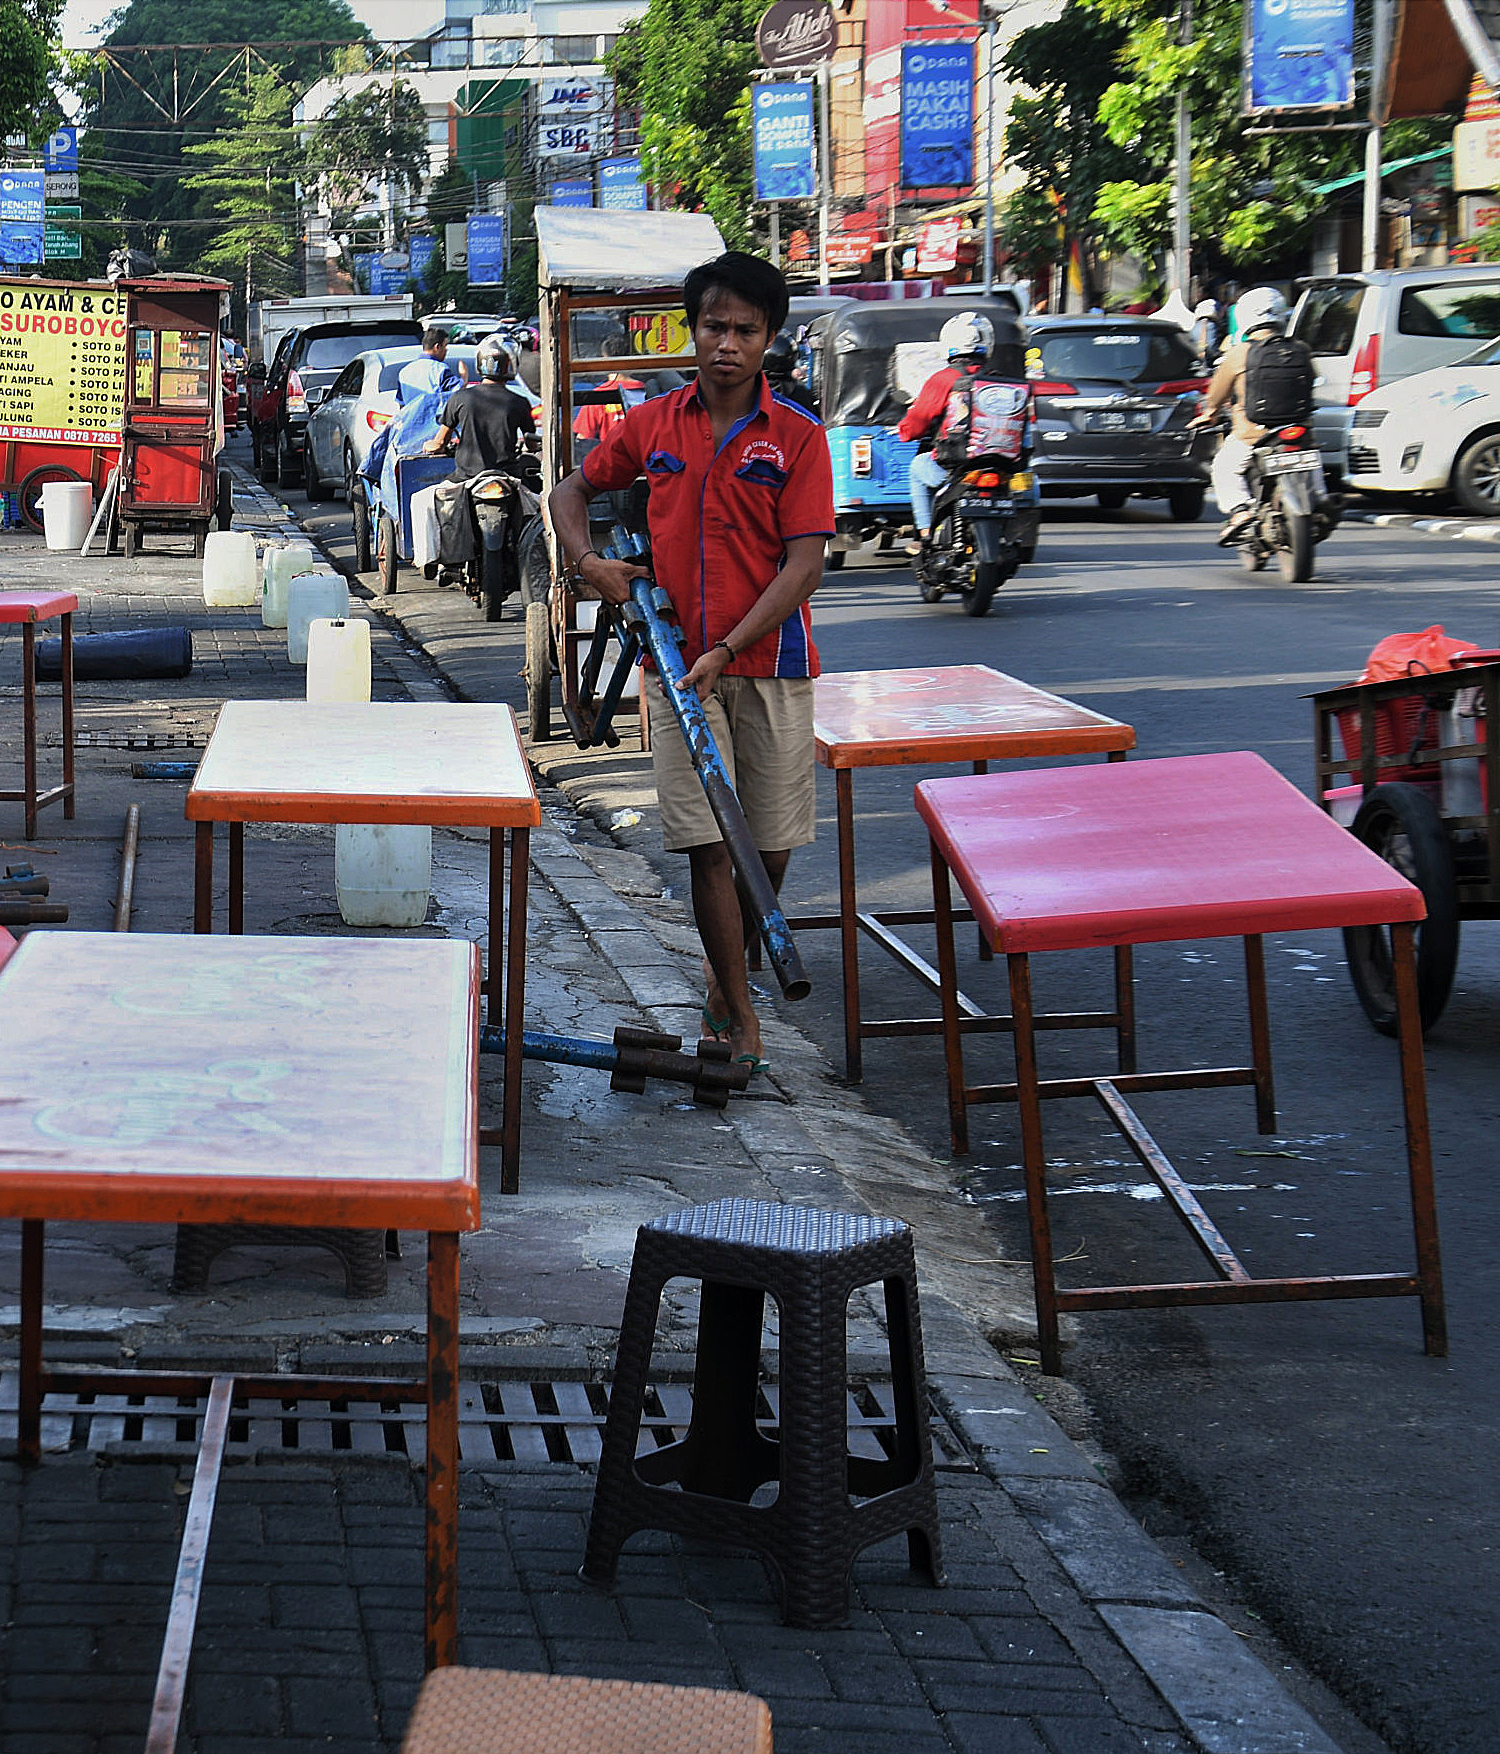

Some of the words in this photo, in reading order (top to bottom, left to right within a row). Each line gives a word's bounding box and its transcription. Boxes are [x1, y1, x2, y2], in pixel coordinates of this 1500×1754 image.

[906, 80, 969, 97] MASIH
[906, 95, 969, 114] PAKAI
[907, 112, 969, 131] CASH?
[50, 132, 71, 165] P
[46, 182, 77, 191] SERONG
[1, 200, 41, 209] PENGEN
[20, 292, 74, 312] AYAM
[81, 296, 94, 313] &
[83, 342, 111, 351] SOTO
[82, 354, 110, 364] SOTO
[81, 367, 109, 377] SOTO
[10, 376, 54, 386] AMPELA
[80, 380, 109, 389] SOTO
[79, 393, 108, 402] SOTO
[10, 401, 34, 410] SAPI
[79, 405, 107, 414] SOTO
[78, 418, 107, 427] SOTO
[12, 427, 62, 440] PESANAN
[64, 430, 89, 442] 0878
[92, 431, 117, 443] 7265
